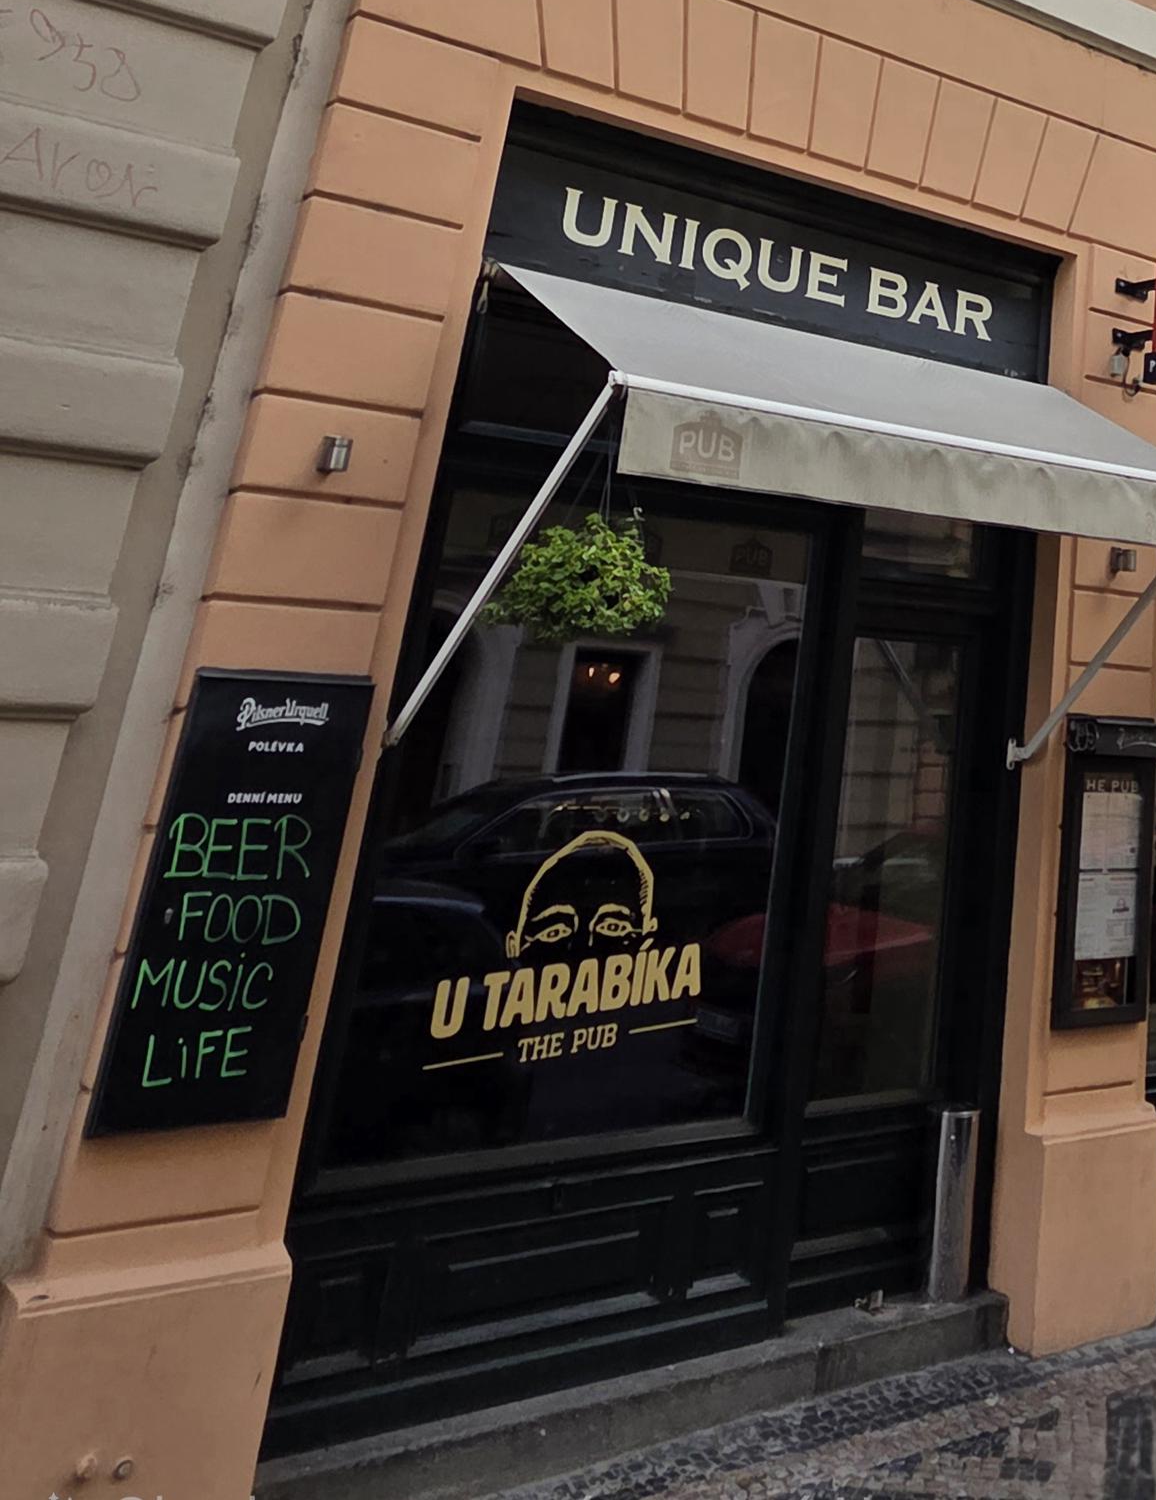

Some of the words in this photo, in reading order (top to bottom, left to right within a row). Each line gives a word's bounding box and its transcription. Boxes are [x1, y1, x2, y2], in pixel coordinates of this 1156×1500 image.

[562, 187, 848, 307] UNIQUE
[866, 267, 993, 342] BAR
[679, 429, 735, 462] PUB
[248, 740, 304, 753] POLÉVKA
[227, 791, 267, 804] DENNÍ
[266, 793, 303, 804] MENU
[1111, 779, 1139, 793] PUB
[163, 812, 311, 880] BEER
[178, 891, 301, 945] FOOD
[430, 976, 470, 1039] U
[482, 938, 701, 1031] TARABÍKA
[517, 1031, 565, 1063] THE
[570, 1023, 619, 1054] PUB
